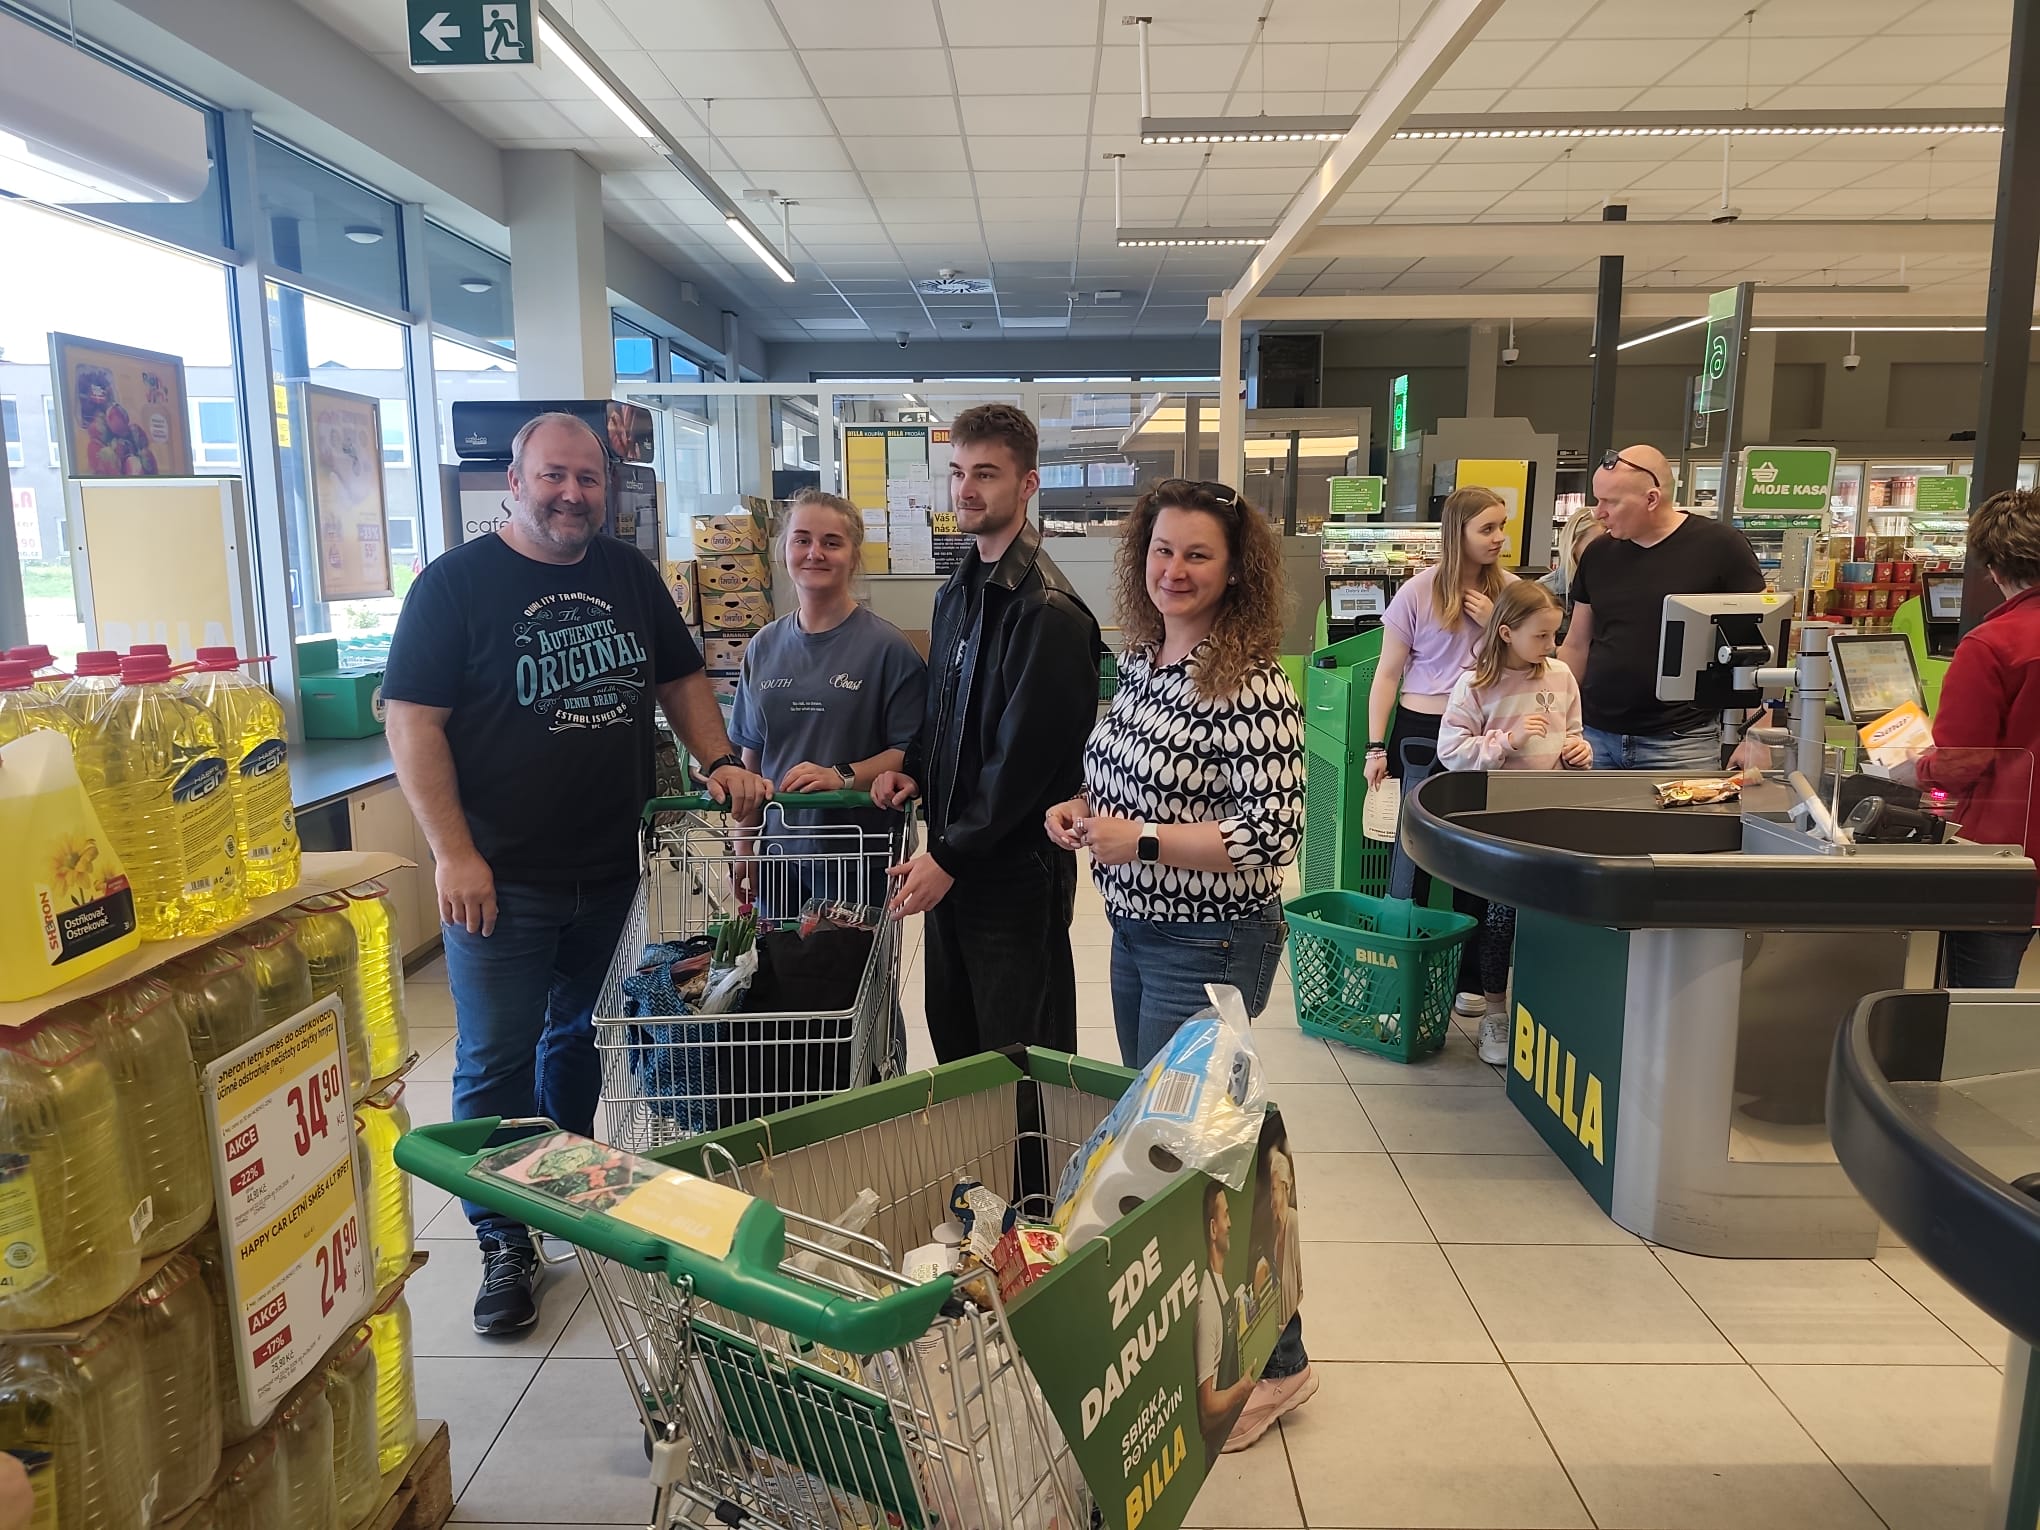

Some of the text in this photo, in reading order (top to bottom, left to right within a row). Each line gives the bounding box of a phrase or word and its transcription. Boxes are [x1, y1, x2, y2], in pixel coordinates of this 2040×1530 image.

[1752, 485, 1828, 496] MOJE KASA
[934, 512, 950, 522] Váš
[934, 524, 950, 533] nás
[523, 592, 613, 618] QUALITY TRADEMARK
[558, 606, 581, 622] The
[537, 619, 617, 655] AUTHENTIC
[516, 632, 647, 706] ORIGINAL
[760, 673, 863, 691] SOUTH Coast
[555, 702, 627, 724] ESTABLISHED 86
[563, 692, 618, 710] DENIM BRAND
[254, 751, 285, 777] car
[190, 770, 223, 801] car
[39, 891, 59, 950] SHERON
[64, 906, 105, 930] Ostřikovač
[66, 915, 109, 940] Ostrekovač
[1355, 948, 1398, 969] BILLA
[1513, 1001, 1604, 1167] BILLA
[287, 1063, 340, 1157] 34 90
[336, 1111, 345, 1127] Kč
[228, 1125, 257, 1159] AKCE
[236, 1164, 259, 1187] -22%
[240, 1231, 270, 1260] HAPPY
[271, 1217, 288, 1238] CAR
[288, 1196, 309, 1225] LETNÍ
[308, 1184, 325, 1208] SMĚS
[325, 1179, 330, 1190] 4
[336, 1162, 350, 1180] RPET
[316, 1215, 358, 1318] 24 90
[1107, 1235, 1162, 1331] ZDE
[252, 1295, 286, 1332] AKCE
[262, 1334, 285, 1357] -17%
[1080, 1259, 1199, 1441] DARUJTE
[1123, 1384, 1183, 1479] POTRAVIN
[1125, 1424, 1187, 1530] BILLA
